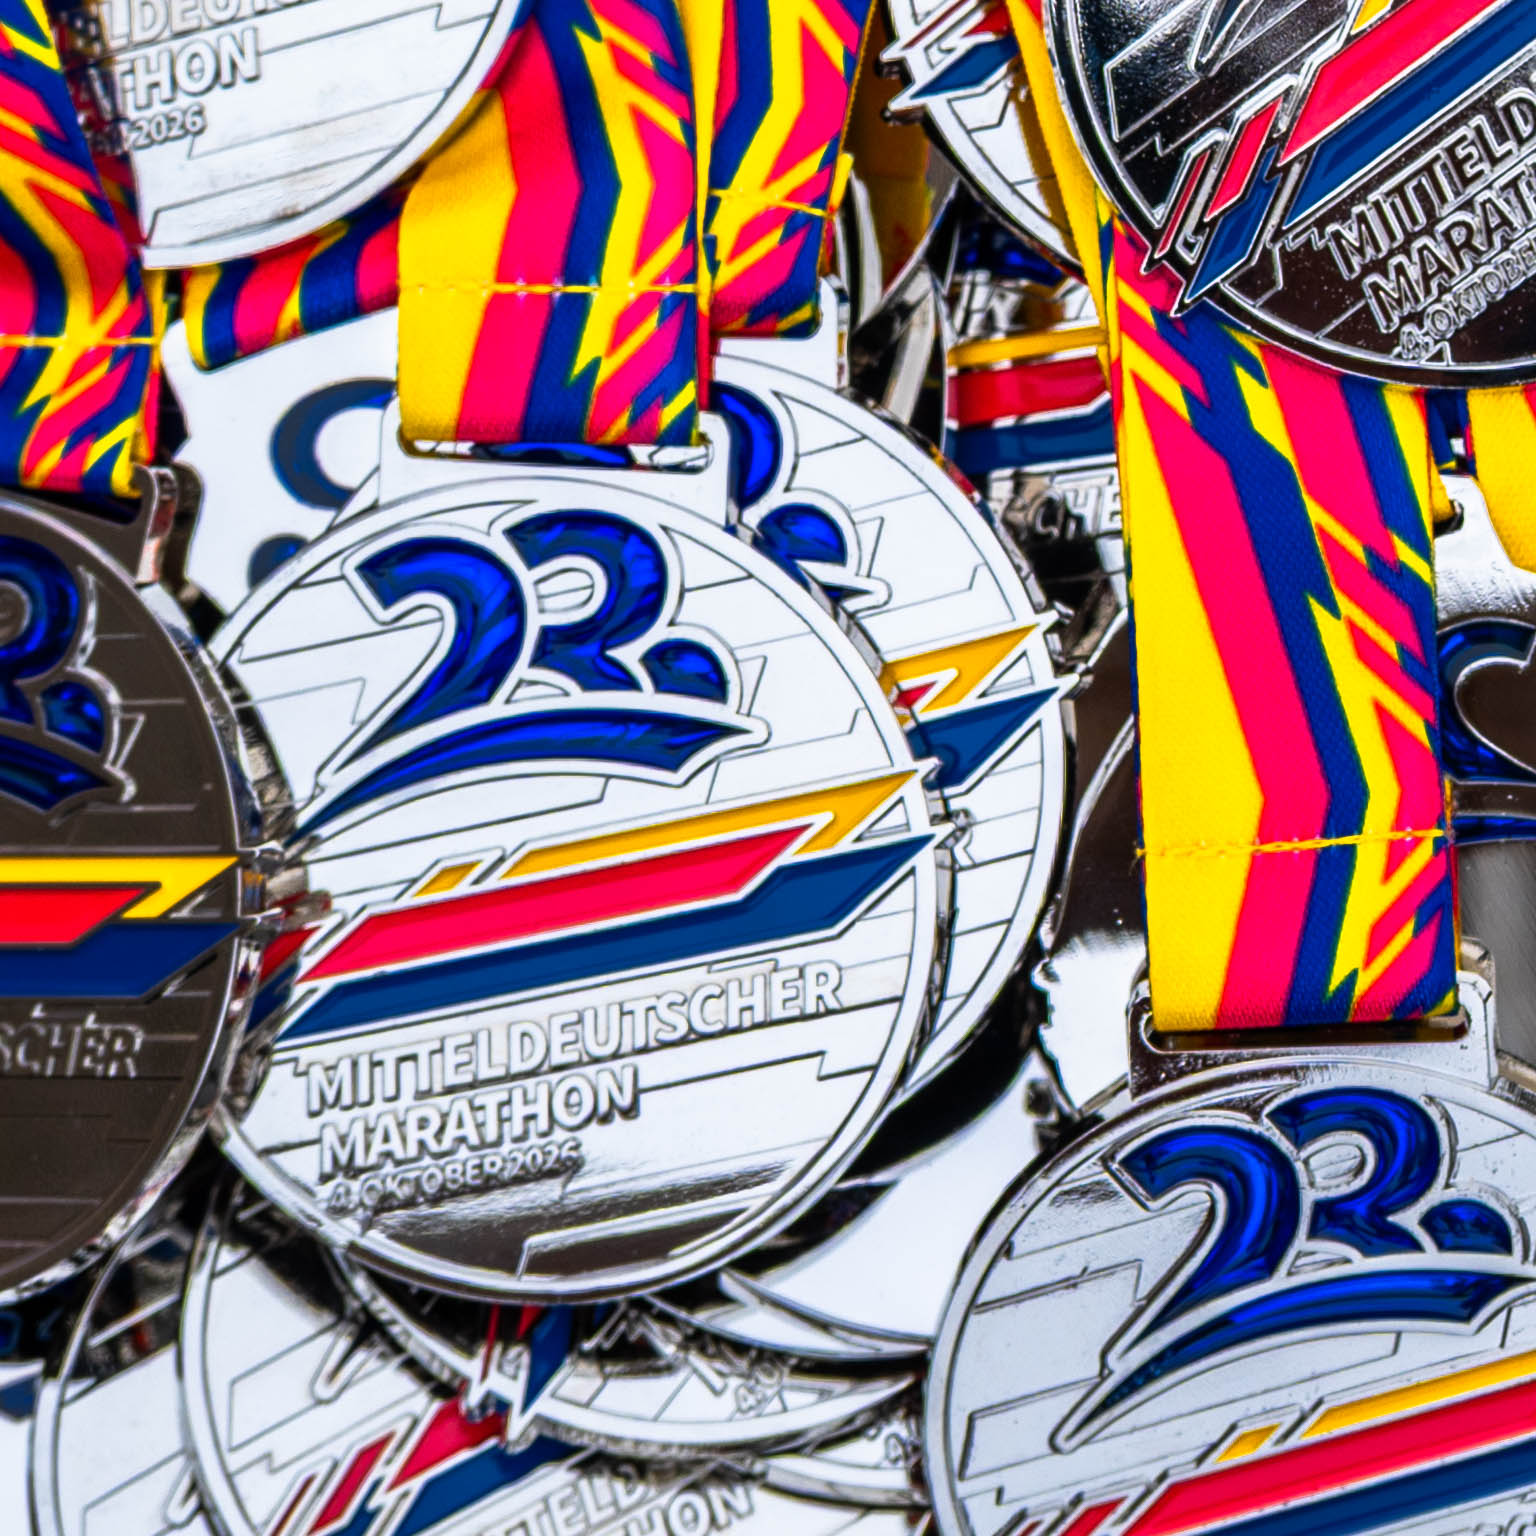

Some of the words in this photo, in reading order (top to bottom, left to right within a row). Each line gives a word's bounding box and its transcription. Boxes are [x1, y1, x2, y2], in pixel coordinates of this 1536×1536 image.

[307, 960, 843, 1118] MITTELDEUTSCHER
[318, 1063, 640, 1183] MARATHON
[358, 1153, 505, 1209] OKTOBER
